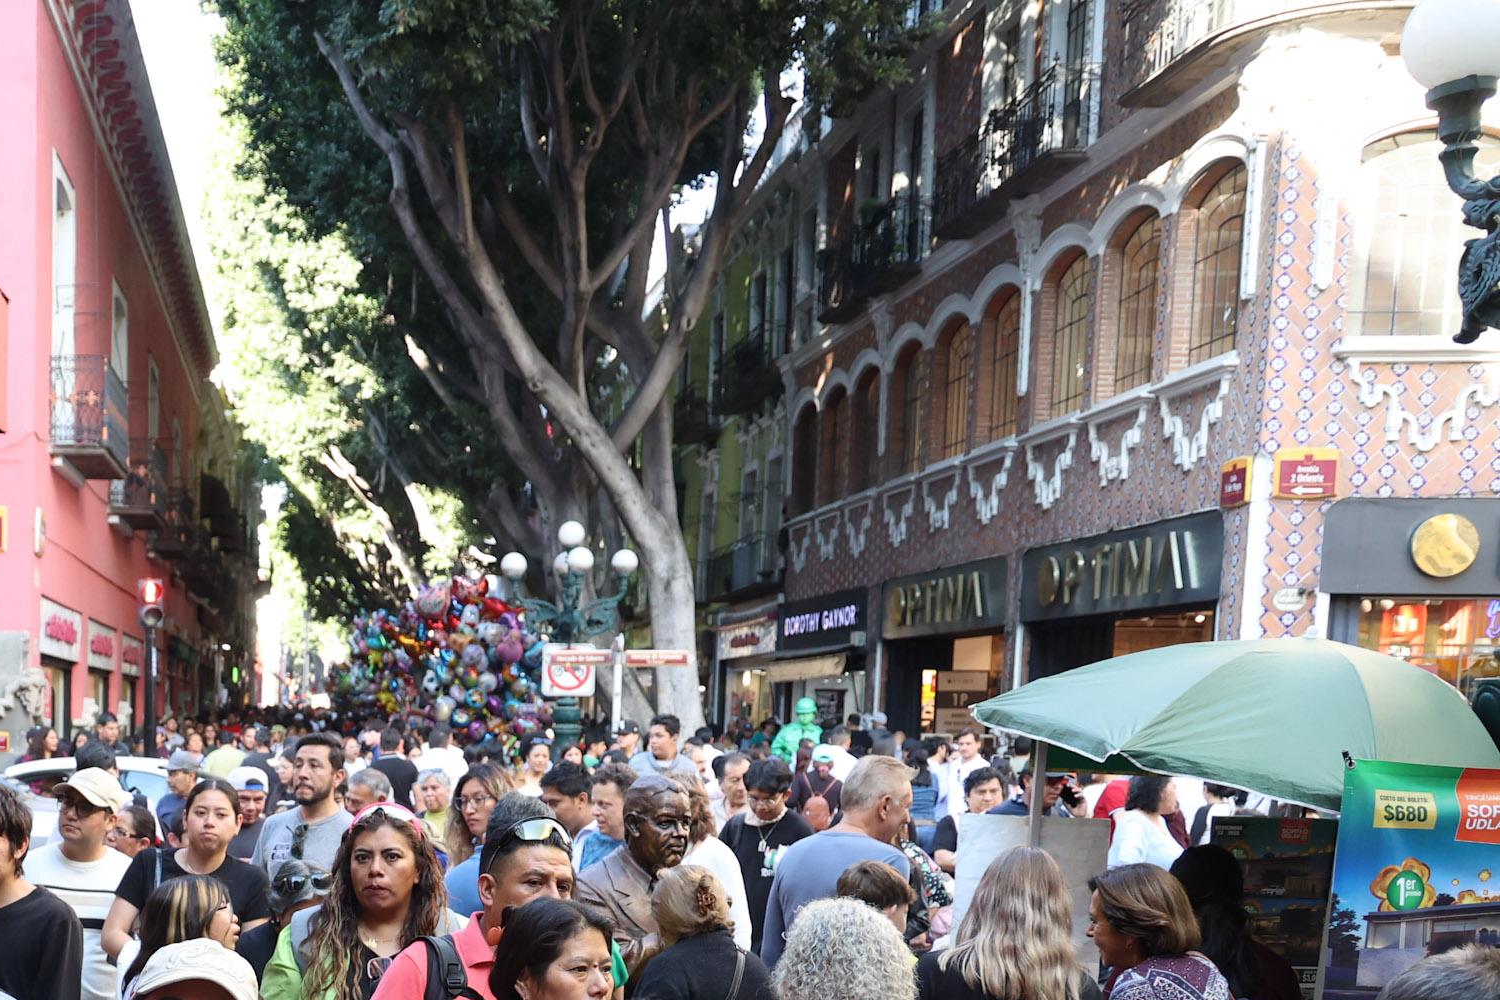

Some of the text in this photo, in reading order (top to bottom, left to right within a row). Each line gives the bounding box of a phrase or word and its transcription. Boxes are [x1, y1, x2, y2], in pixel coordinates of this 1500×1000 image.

[784, 605, 857, 637] DOROTHY GAYNOR
[1384, 804, 1428, 823] $680
